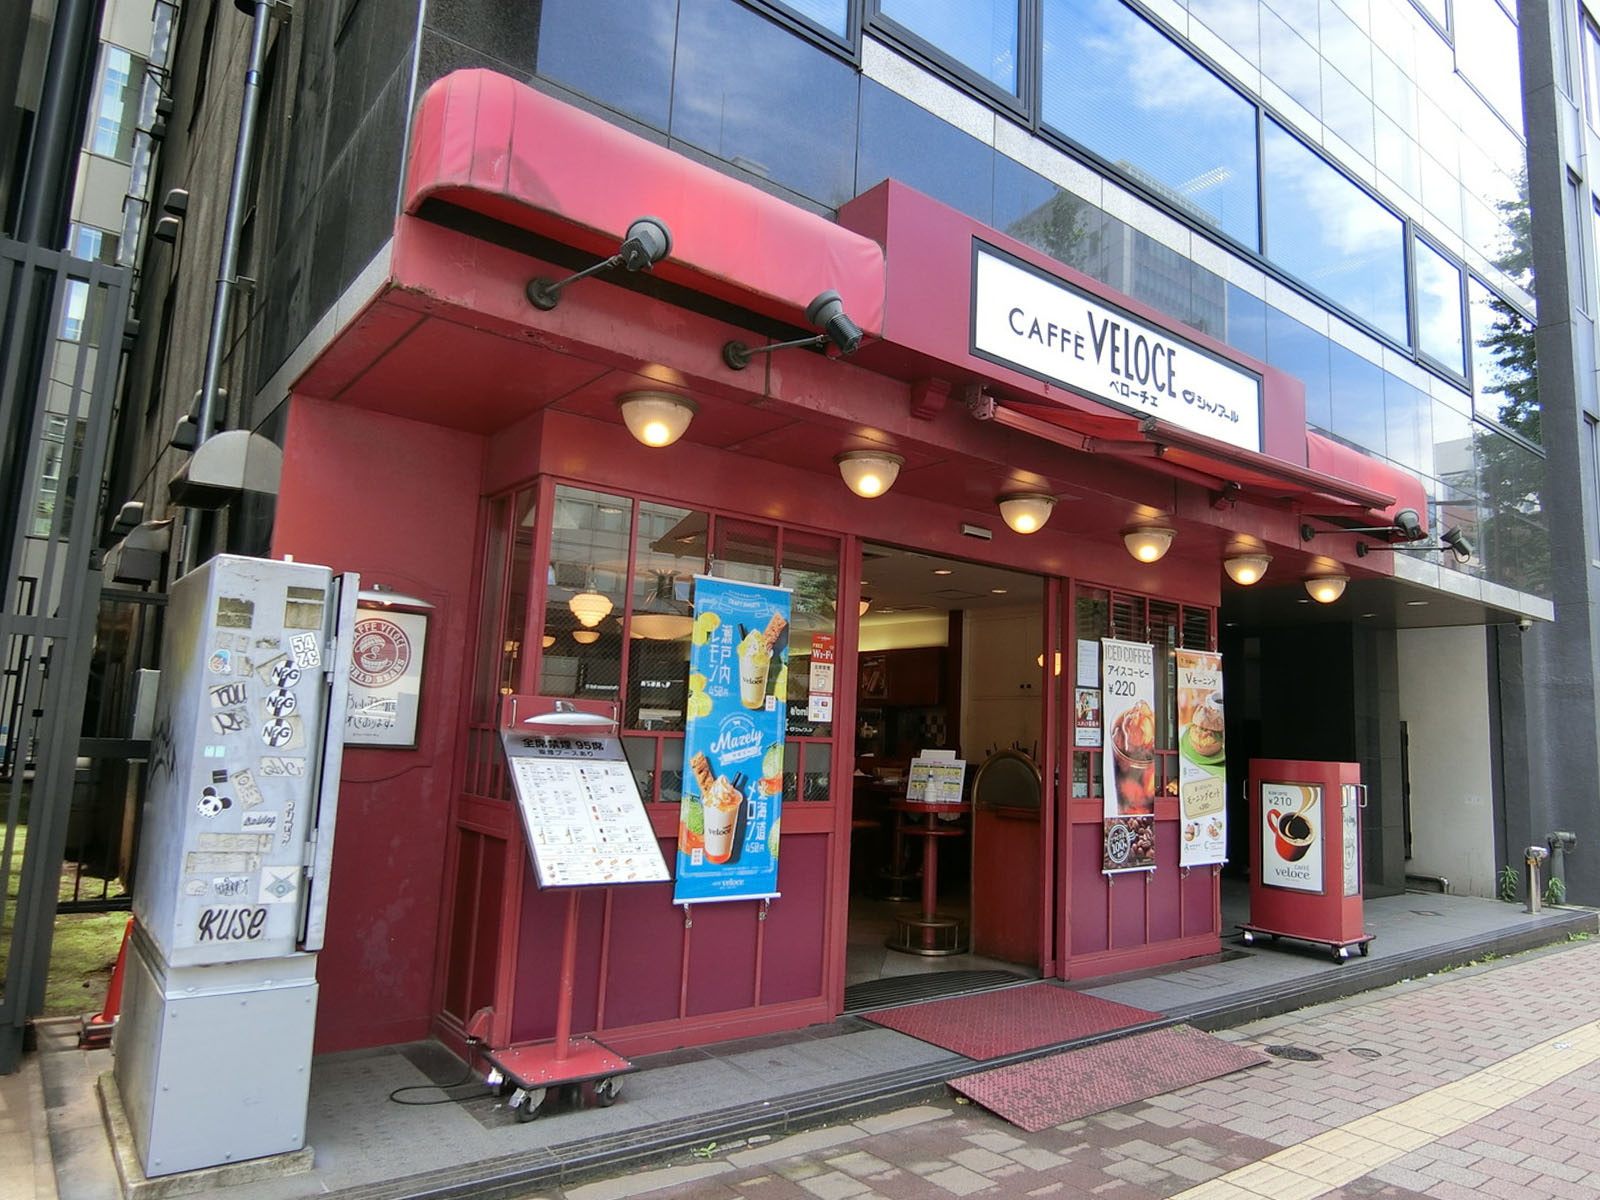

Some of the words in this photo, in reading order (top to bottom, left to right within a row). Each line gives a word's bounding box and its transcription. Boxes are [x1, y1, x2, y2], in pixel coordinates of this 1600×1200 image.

[1087, 310, 1177, 399] VELOCE
[1109, 379, 1159, 408] ベローチェ
[1197, 394, 1239, 424] シャノアール
[708, 624, 720, 683] レモン
[719, 624, 733, 685] 瀬戸内
[812, 648, 833, 661] Wi-Fi
[1105, 647, 1123, 663] ICED
[1123, 648, 1152, 665] COFFEE
[1107, 664, 1150, 679] アイスコーヒー
[1108, 680, 1136, 697] ¥220
[521, 736, 573, 750] 全席禁煙
[710, 728, 764, 753] Mazely
[745, 781, 757, 841] メロン
[1268, 796, 1292, 807] ¥210
[1274, 866, 1311, 880] veloce
